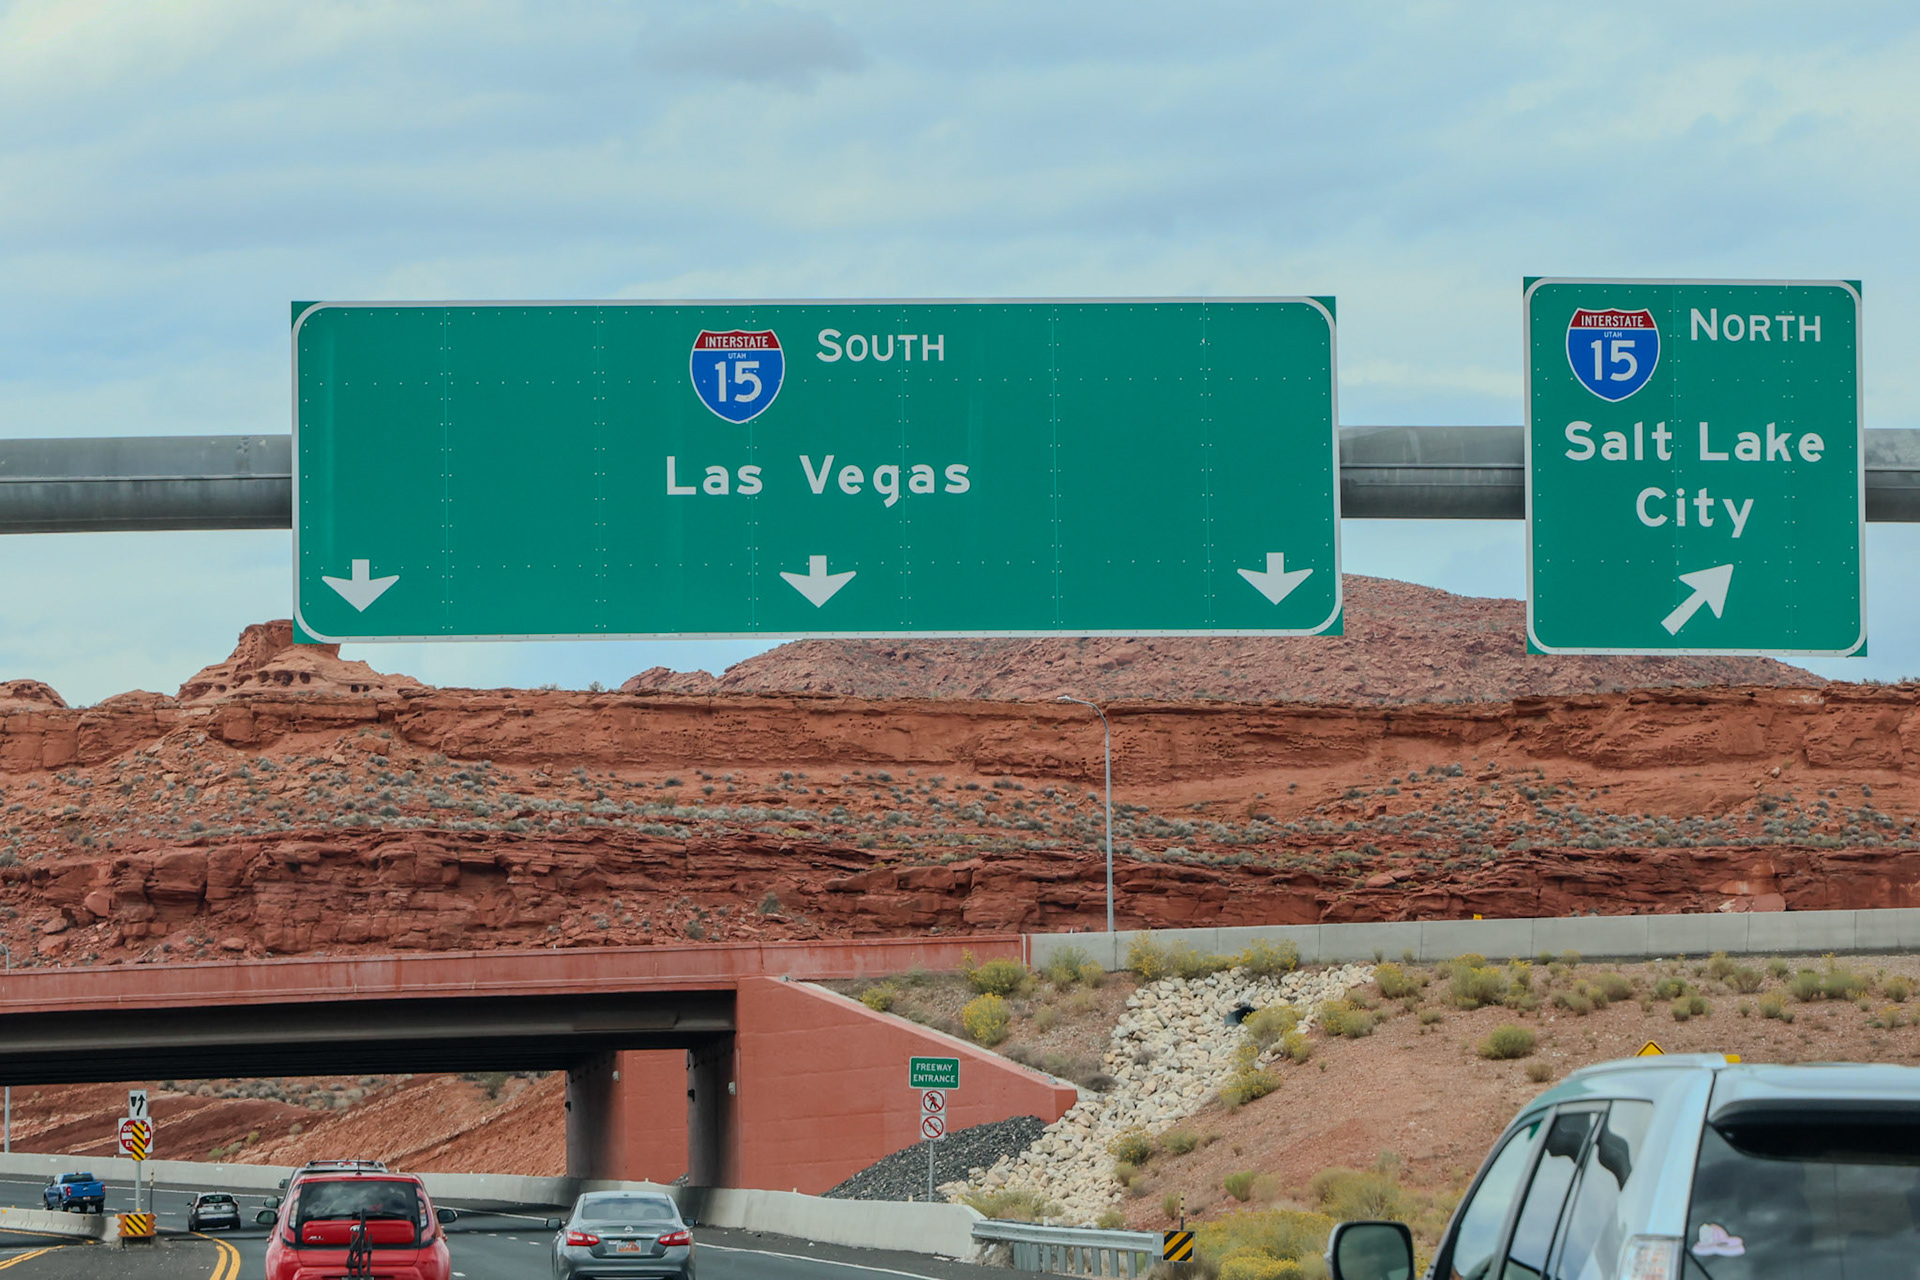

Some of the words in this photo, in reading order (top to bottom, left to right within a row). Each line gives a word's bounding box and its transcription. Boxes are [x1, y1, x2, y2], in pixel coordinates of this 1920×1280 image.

[1581, 315, 1644, 327] INTERSTATE
[1690, 308, 1821, 342] NORTH
[705, 336, 769, 348] INTERSTATE
[816, 328, 945, 362] SOUTH
[1590, 339, 1638, 382] 15
[714, 361, 762, 403] 15
[1564, 420, 1673, 461] Salt
[1699, 421, 1825, 462] Lake
[666, 456, 764, 495] Las
[799, 454, 971, 508] Vegas
[1636, 486, 1754, 538] City
[913, 1074, 956, 1083] ENTRANCE
[916, 1063, 953, 1072] FREEWAY
